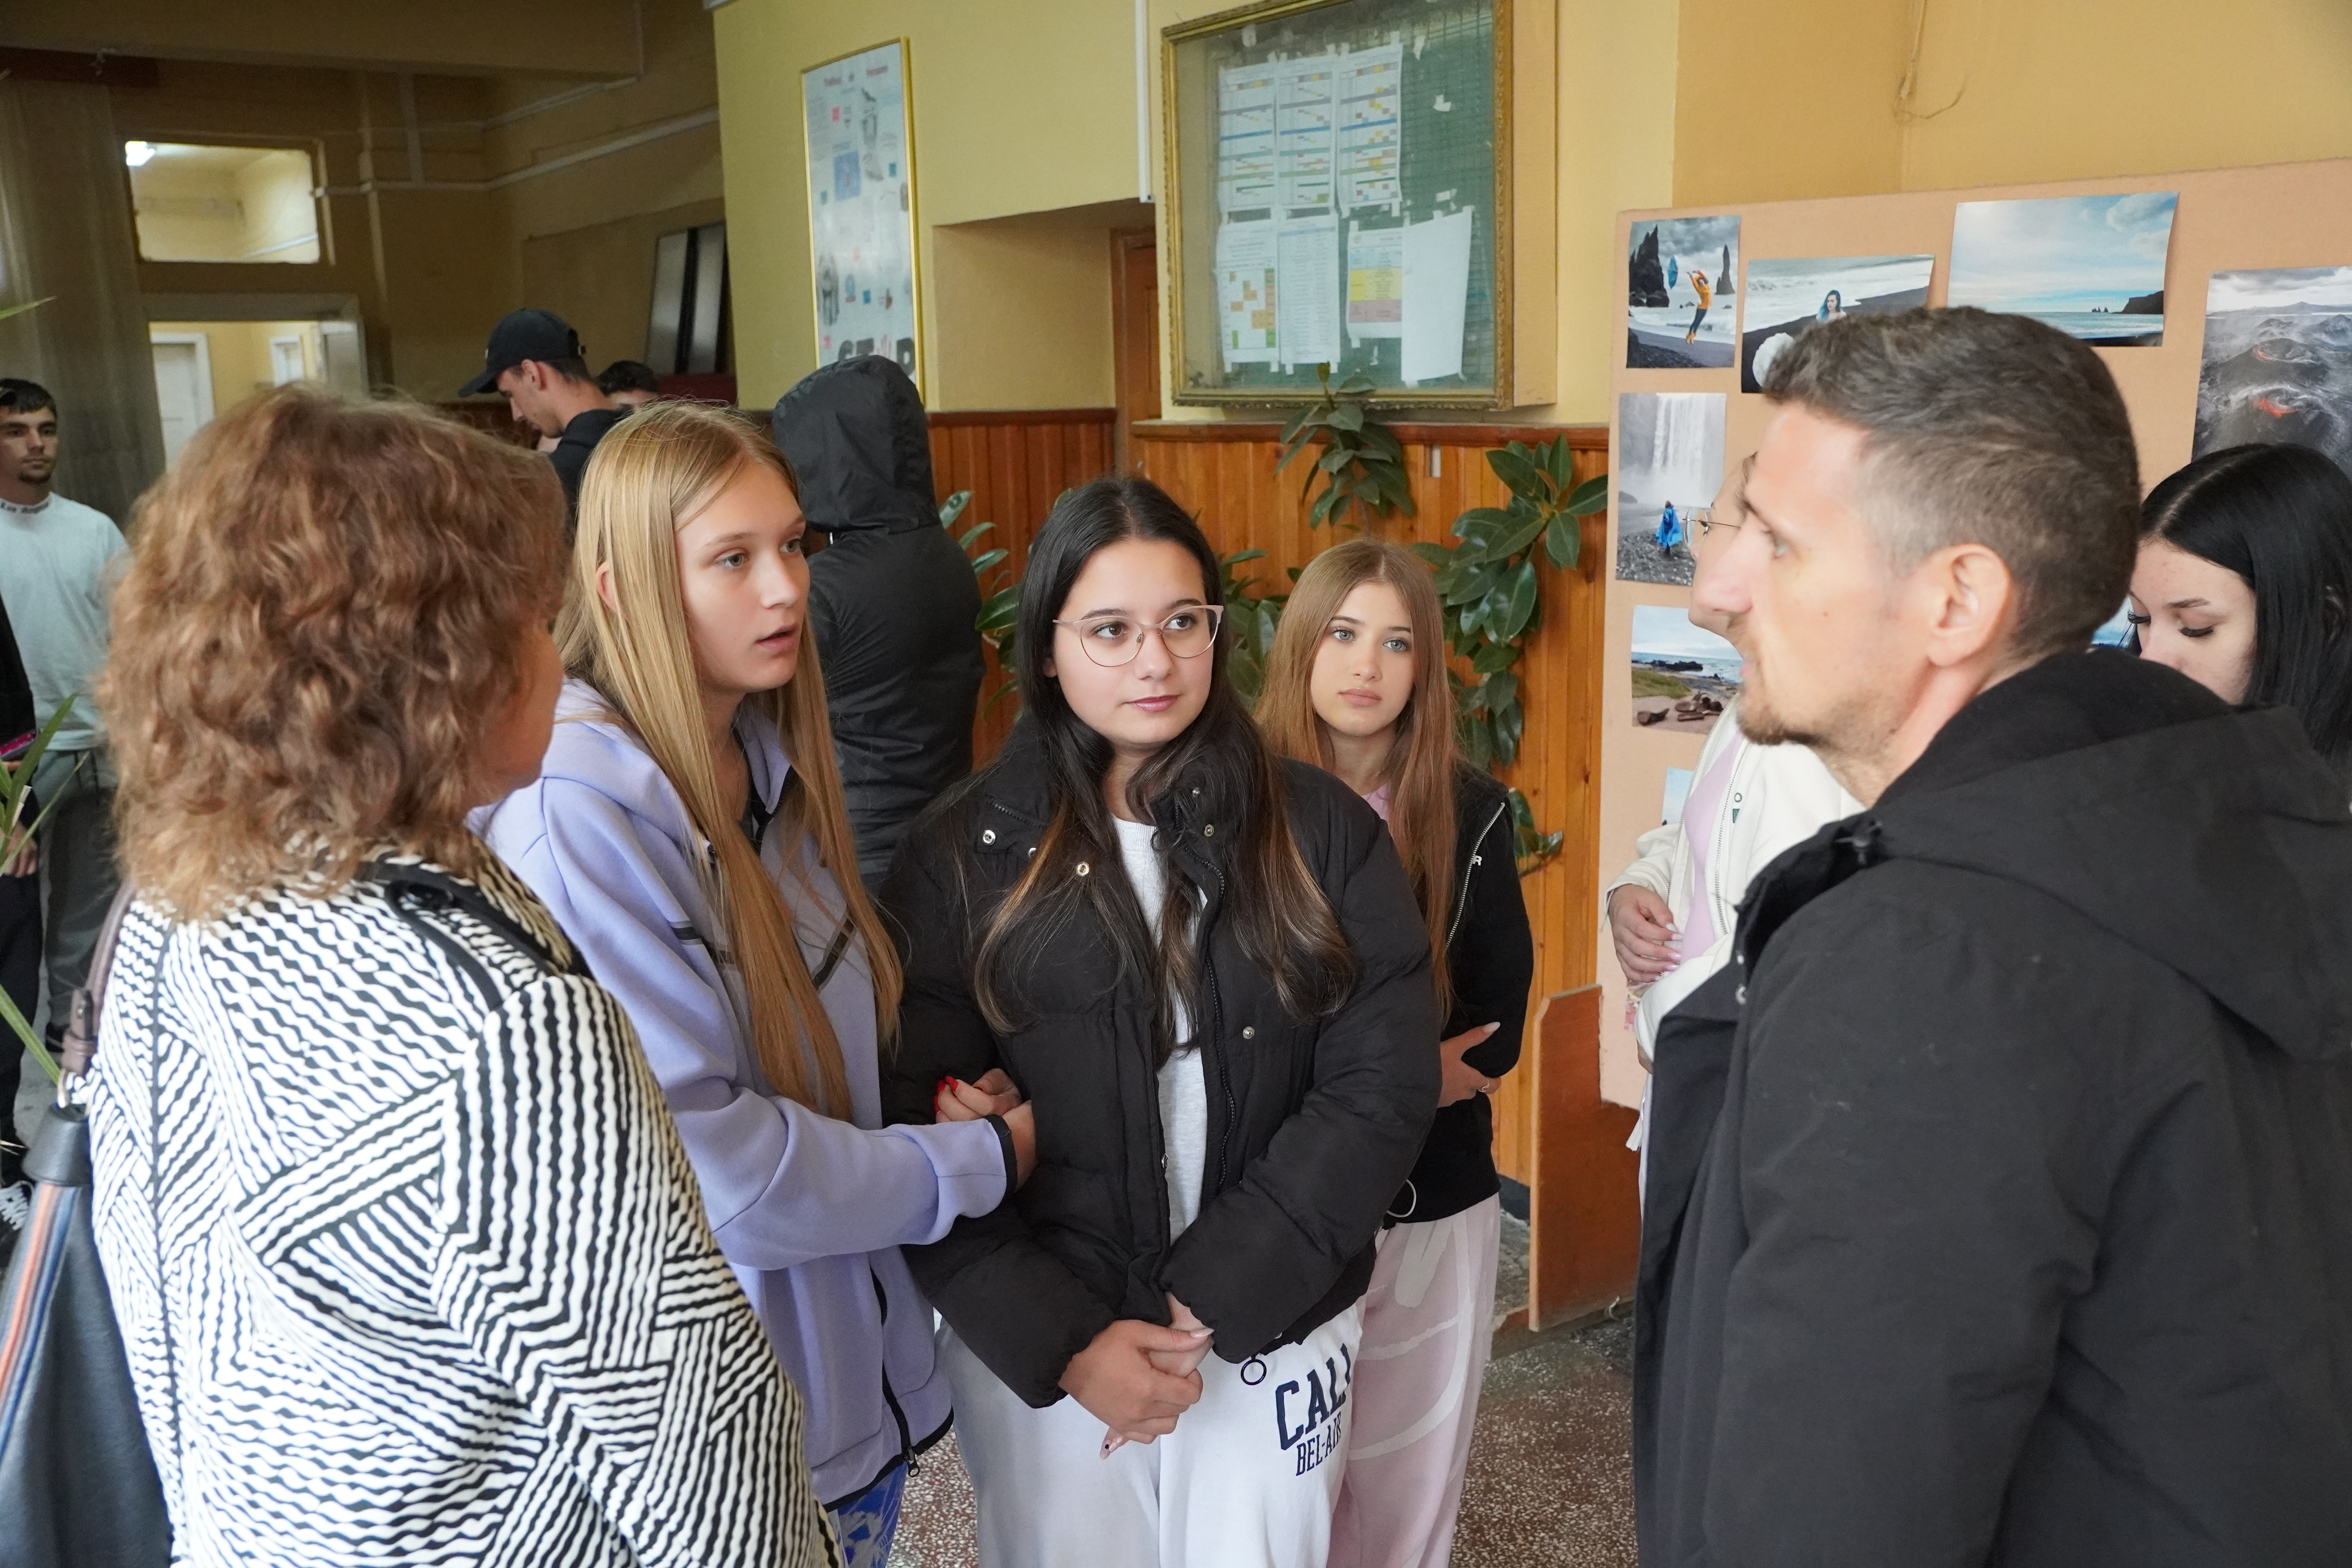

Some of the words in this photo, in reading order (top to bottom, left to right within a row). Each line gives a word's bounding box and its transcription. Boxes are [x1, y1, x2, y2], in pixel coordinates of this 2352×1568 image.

[1472, 855, 1482, 866] R
[1276, 1343, 1351, 1450] CALI
[1296, 1411, 1341, 1476] BEL-AIR
